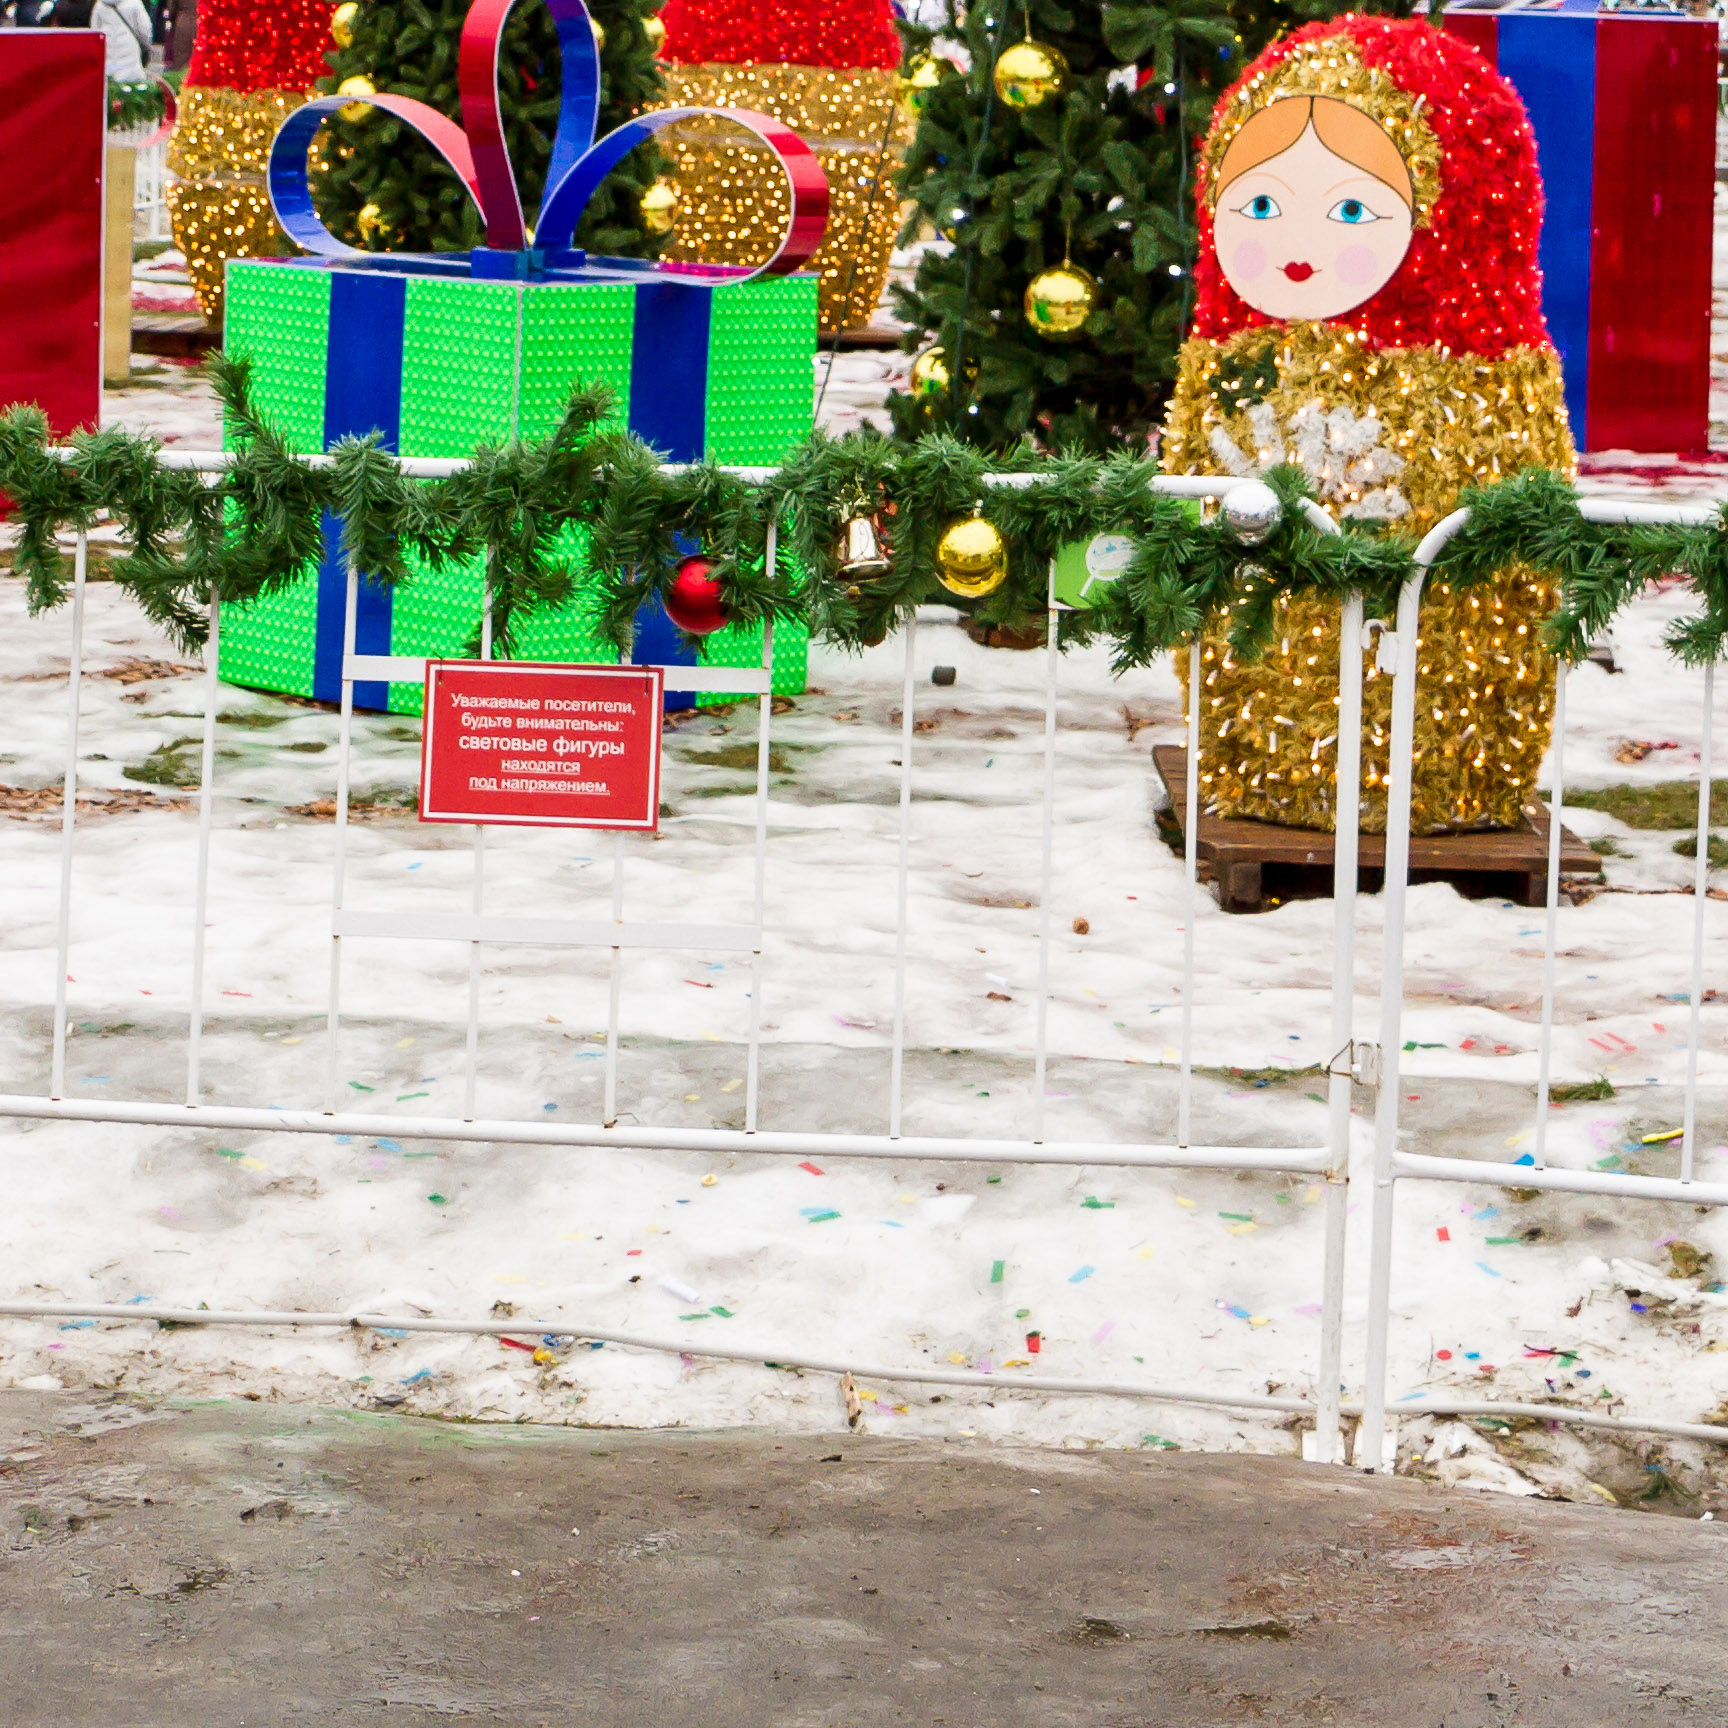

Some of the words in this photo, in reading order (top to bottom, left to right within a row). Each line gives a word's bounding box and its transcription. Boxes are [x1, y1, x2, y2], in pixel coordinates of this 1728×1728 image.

[450, 693, 540, 710] Уважаемые
[544, 698, 637, 716] посетители,
[461, 712, 512, 731] будьте
[516, 716, 625, 733] внимательны:
[458, 735, 548, 752] световые
[552, 735, 625, 758] фигуры
[500, 759, 581, 775] находятся
[468, 775, 498, 791] под
[500, 779, 611, 795] напряжением.
